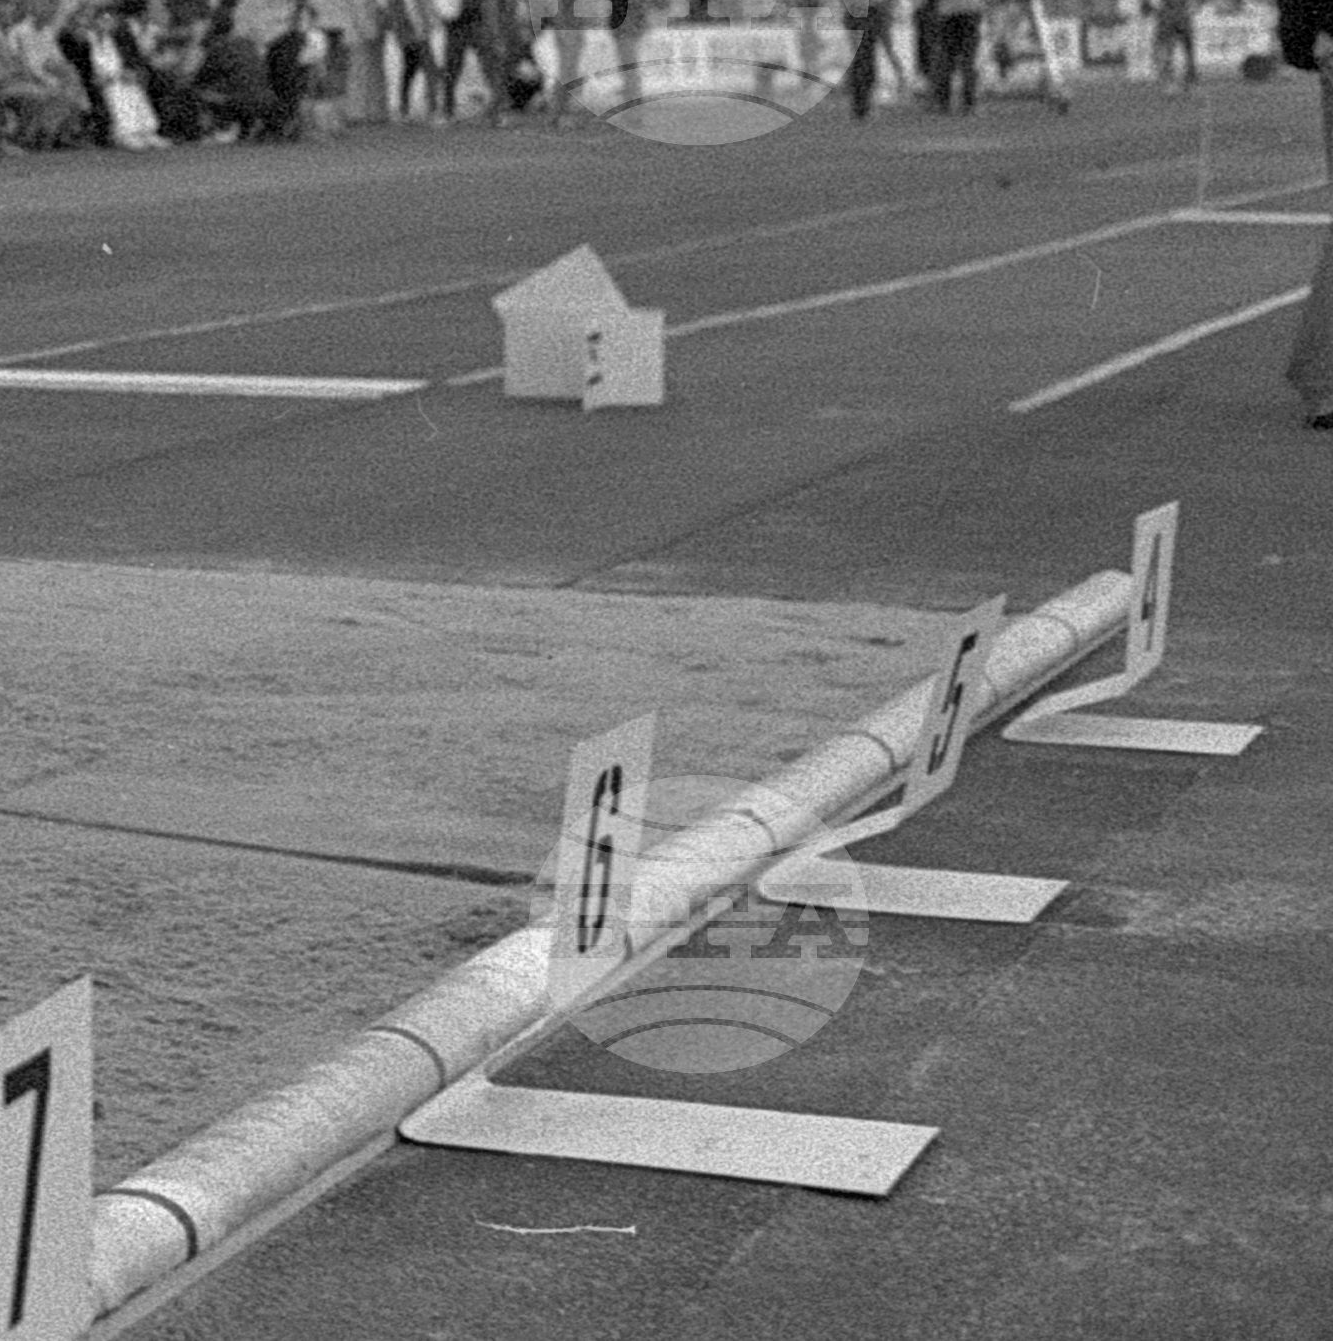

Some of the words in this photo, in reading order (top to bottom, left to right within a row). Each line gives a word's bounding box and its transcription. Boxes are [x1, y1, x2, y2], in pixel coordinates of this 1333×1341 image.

[1140, 532, 1162, 651] 4
[926, 631, 980, 775] 5
[576, 763, 623, 954] 6
[2, 1046, 52, 1330] 7
